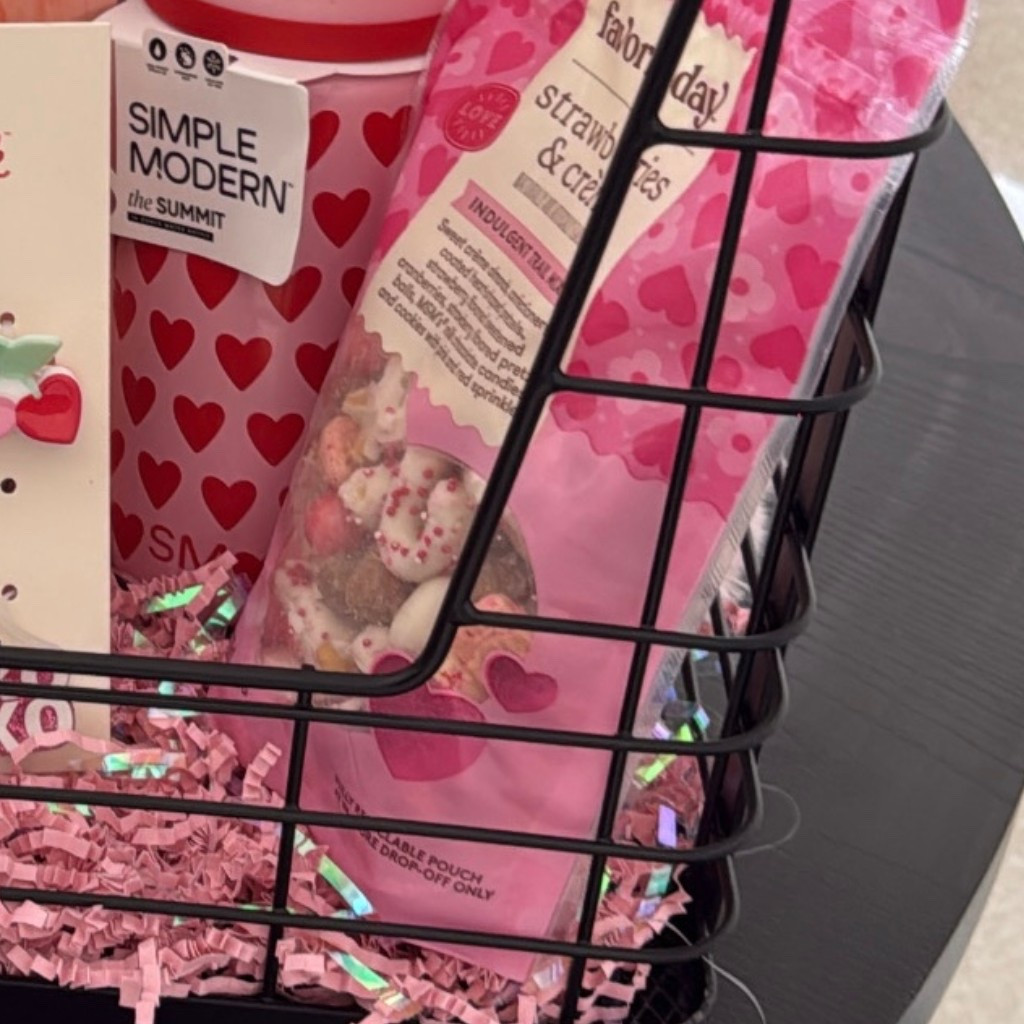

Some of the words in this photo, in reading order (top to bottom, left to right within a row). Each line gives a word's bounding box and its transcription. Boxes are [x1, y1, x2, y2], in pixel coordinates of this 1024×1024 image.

[457, 101, 504, 130] LOVE
[669, 64, 730, 130] day
[128, 100, 258, 165] SIMPLE
[537, 136, 568, 176] &
[129, 140, 289, 215] MODERN
[127, 188, 154, 212] the
[156, 195, 226, 230] SUMMIT
[436, 218, 468, 249] Sweet
[467, 195, 531, 259] INDULGENT
[376, 286, 397, 307] and
[393, 301, 429, 336] cookies
[379, 842, 452, 889] DROP-OFF
[452, 880, 496, 902] ONLY
[426, 853, 484, 885] POUCH
